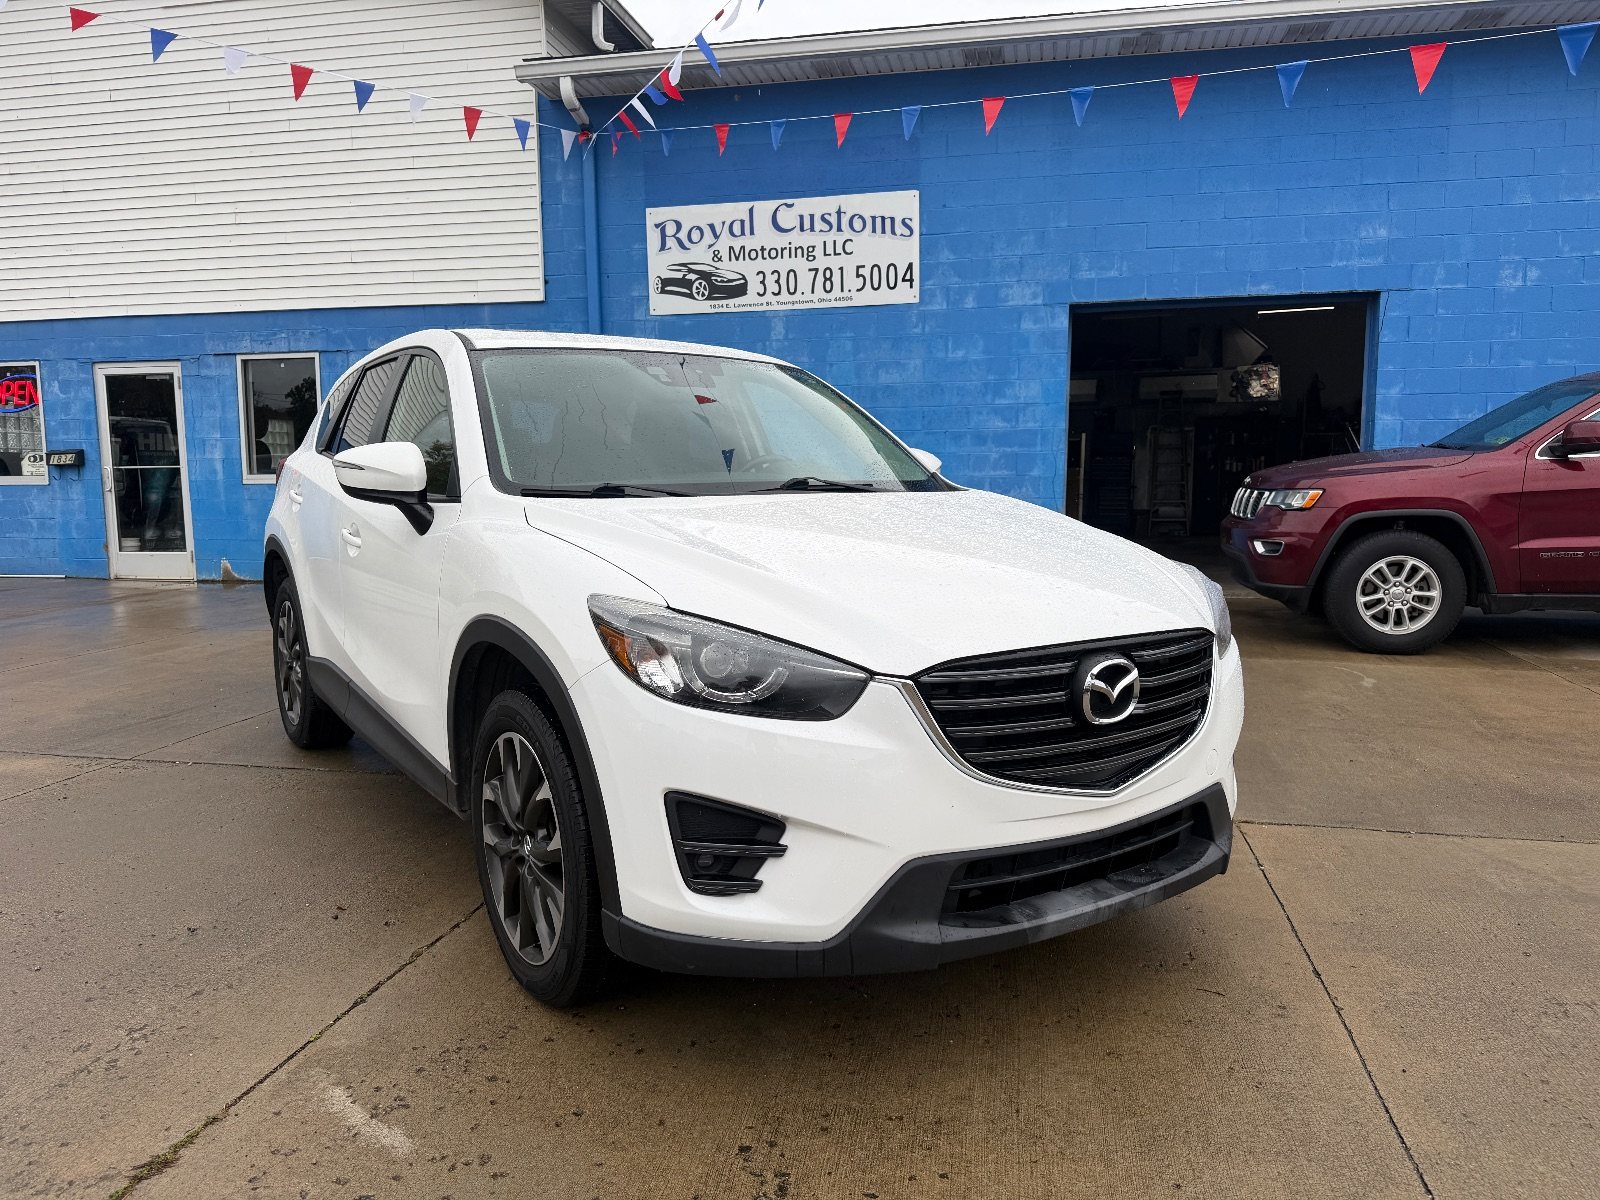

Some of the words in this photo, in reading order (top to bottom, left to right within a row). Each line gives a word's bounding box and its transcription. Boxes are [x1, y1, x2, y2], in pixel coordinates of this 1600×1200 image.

[654, 205, 755, 252] Royal
[771, 202, 914, 237] Customs
[711, 249, 723, 263] &
[728, 241, 816, 262] Motoring
[822, 239, 854, 256] LLC
[756, 262, 914, 297] 330.781.5004
[0, 380, 39, 406] PEN
[51, 454, 74, 464] 1834
